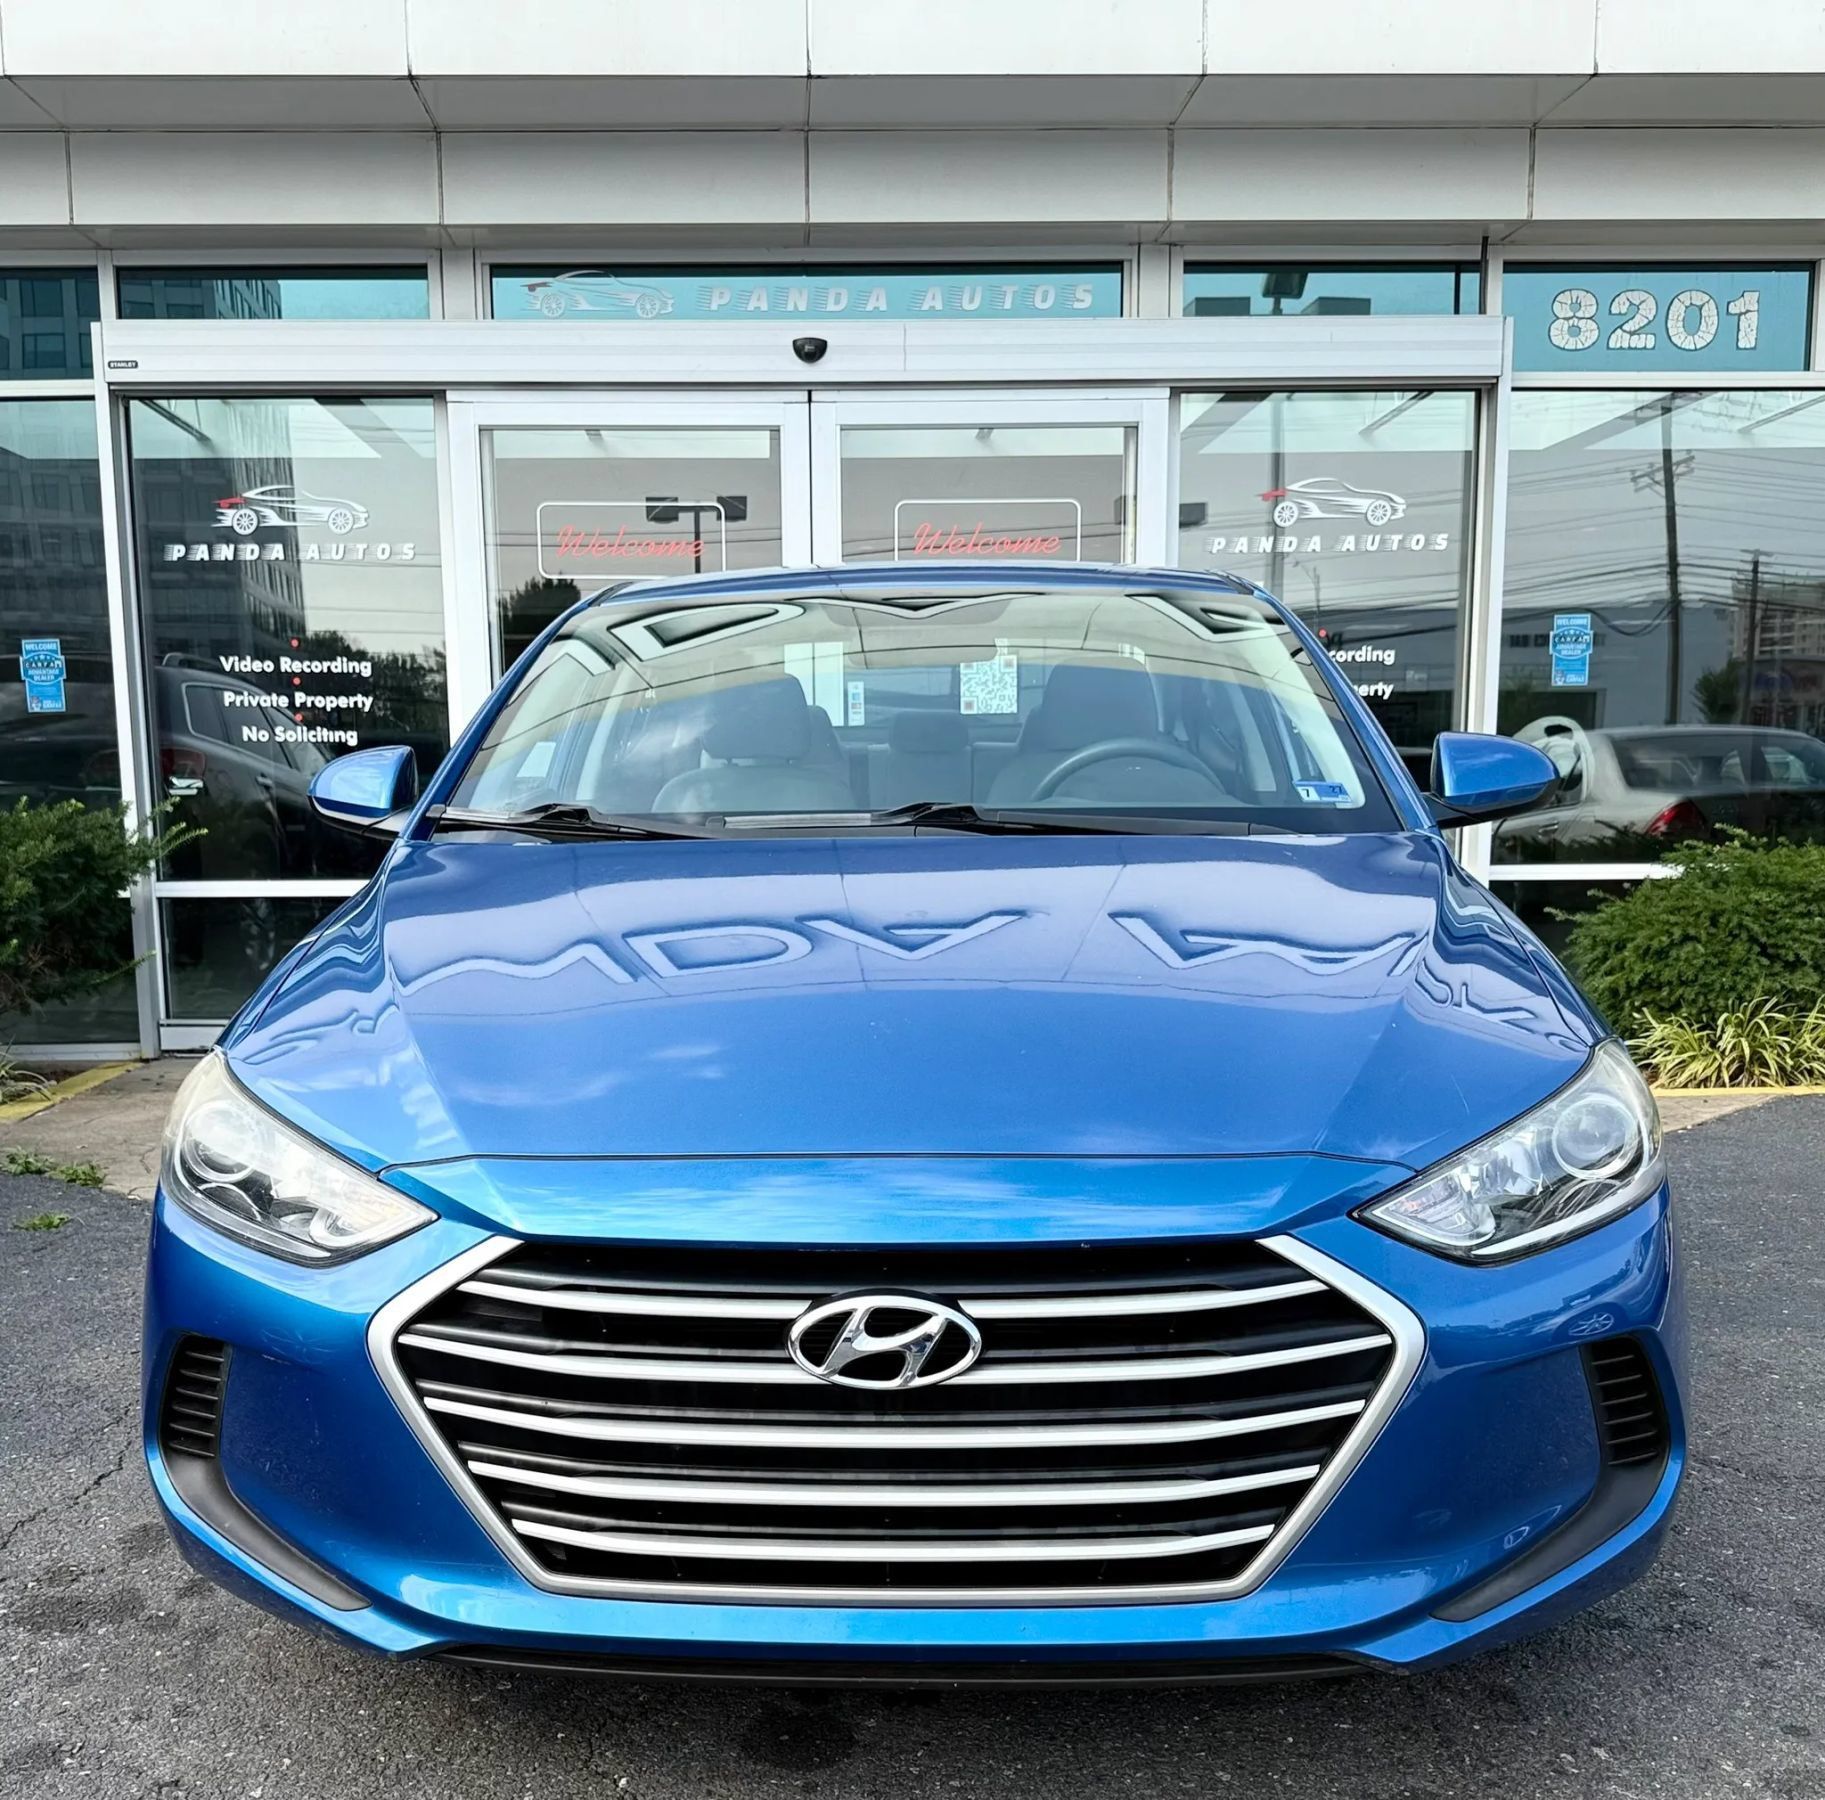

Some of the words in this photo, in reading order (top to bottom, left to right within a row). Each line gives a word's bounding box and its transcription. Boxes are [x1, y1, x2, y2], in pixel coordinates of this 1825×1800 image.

[697, 286, 888, 313] PANDA
[907, 284, 1094, 312] AUTOS
[1548, 288, 1760, 351] 8201
[556, 523, 705, 559] Welcome
[914, 520, 1062, 556] Welcome
[1207, 535, 1322, 555] PANDA
[1336, 532, 1449, 554] AUTOS
[163, 543, 285, 562] PANDA
[299, 543, 416, 562] AUTOS
[25, 643, 57, 651] WELCOME
[219, 655, 275, 673] Video
[280, 656, 372, 677] Recording
[224, 691, 289, 707] Private
[294, 691, 373, 712] Property
[242, 726, 270, 742] No
[275, 726, 358, 746] Soliciting
